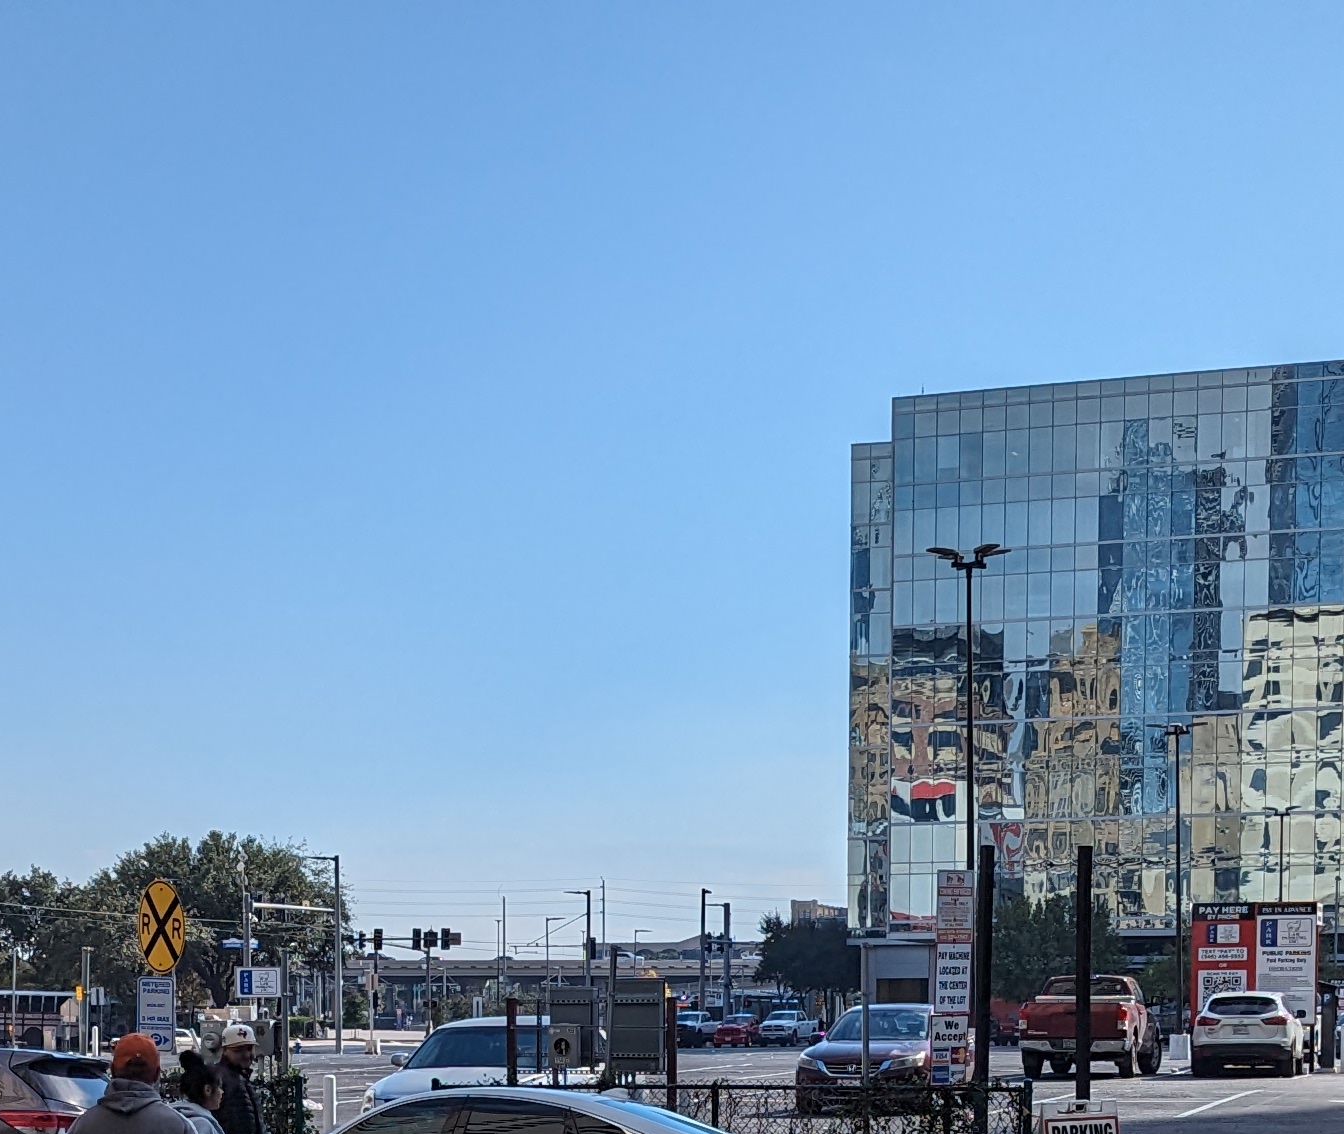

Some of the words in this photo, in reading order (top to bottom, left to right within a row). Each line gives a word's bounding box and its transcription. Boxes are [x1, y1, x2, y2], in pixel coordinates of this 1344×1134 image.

[1198, 906, 1220, 914] PAY
[1221, 905, 1249, 914] HERE
[142, 913, 151, 935] R
[172, 918, 182, 940] R
[938, 951, 948, 960] PAY
[948, 951, 970, 960] MACHINE
[939, 966, 961, 976] LOCATED
[961, 966, 968, 975] AT
[938, 981, 948, 990] THE
[948, 981, 968, 990] CENTER
[939, 996, 947, 1004] OF
[947, 996, 957, 1004] THE
[944, 1020, 960, 1030] We
[934, 1031, 967, 1044] Accept
